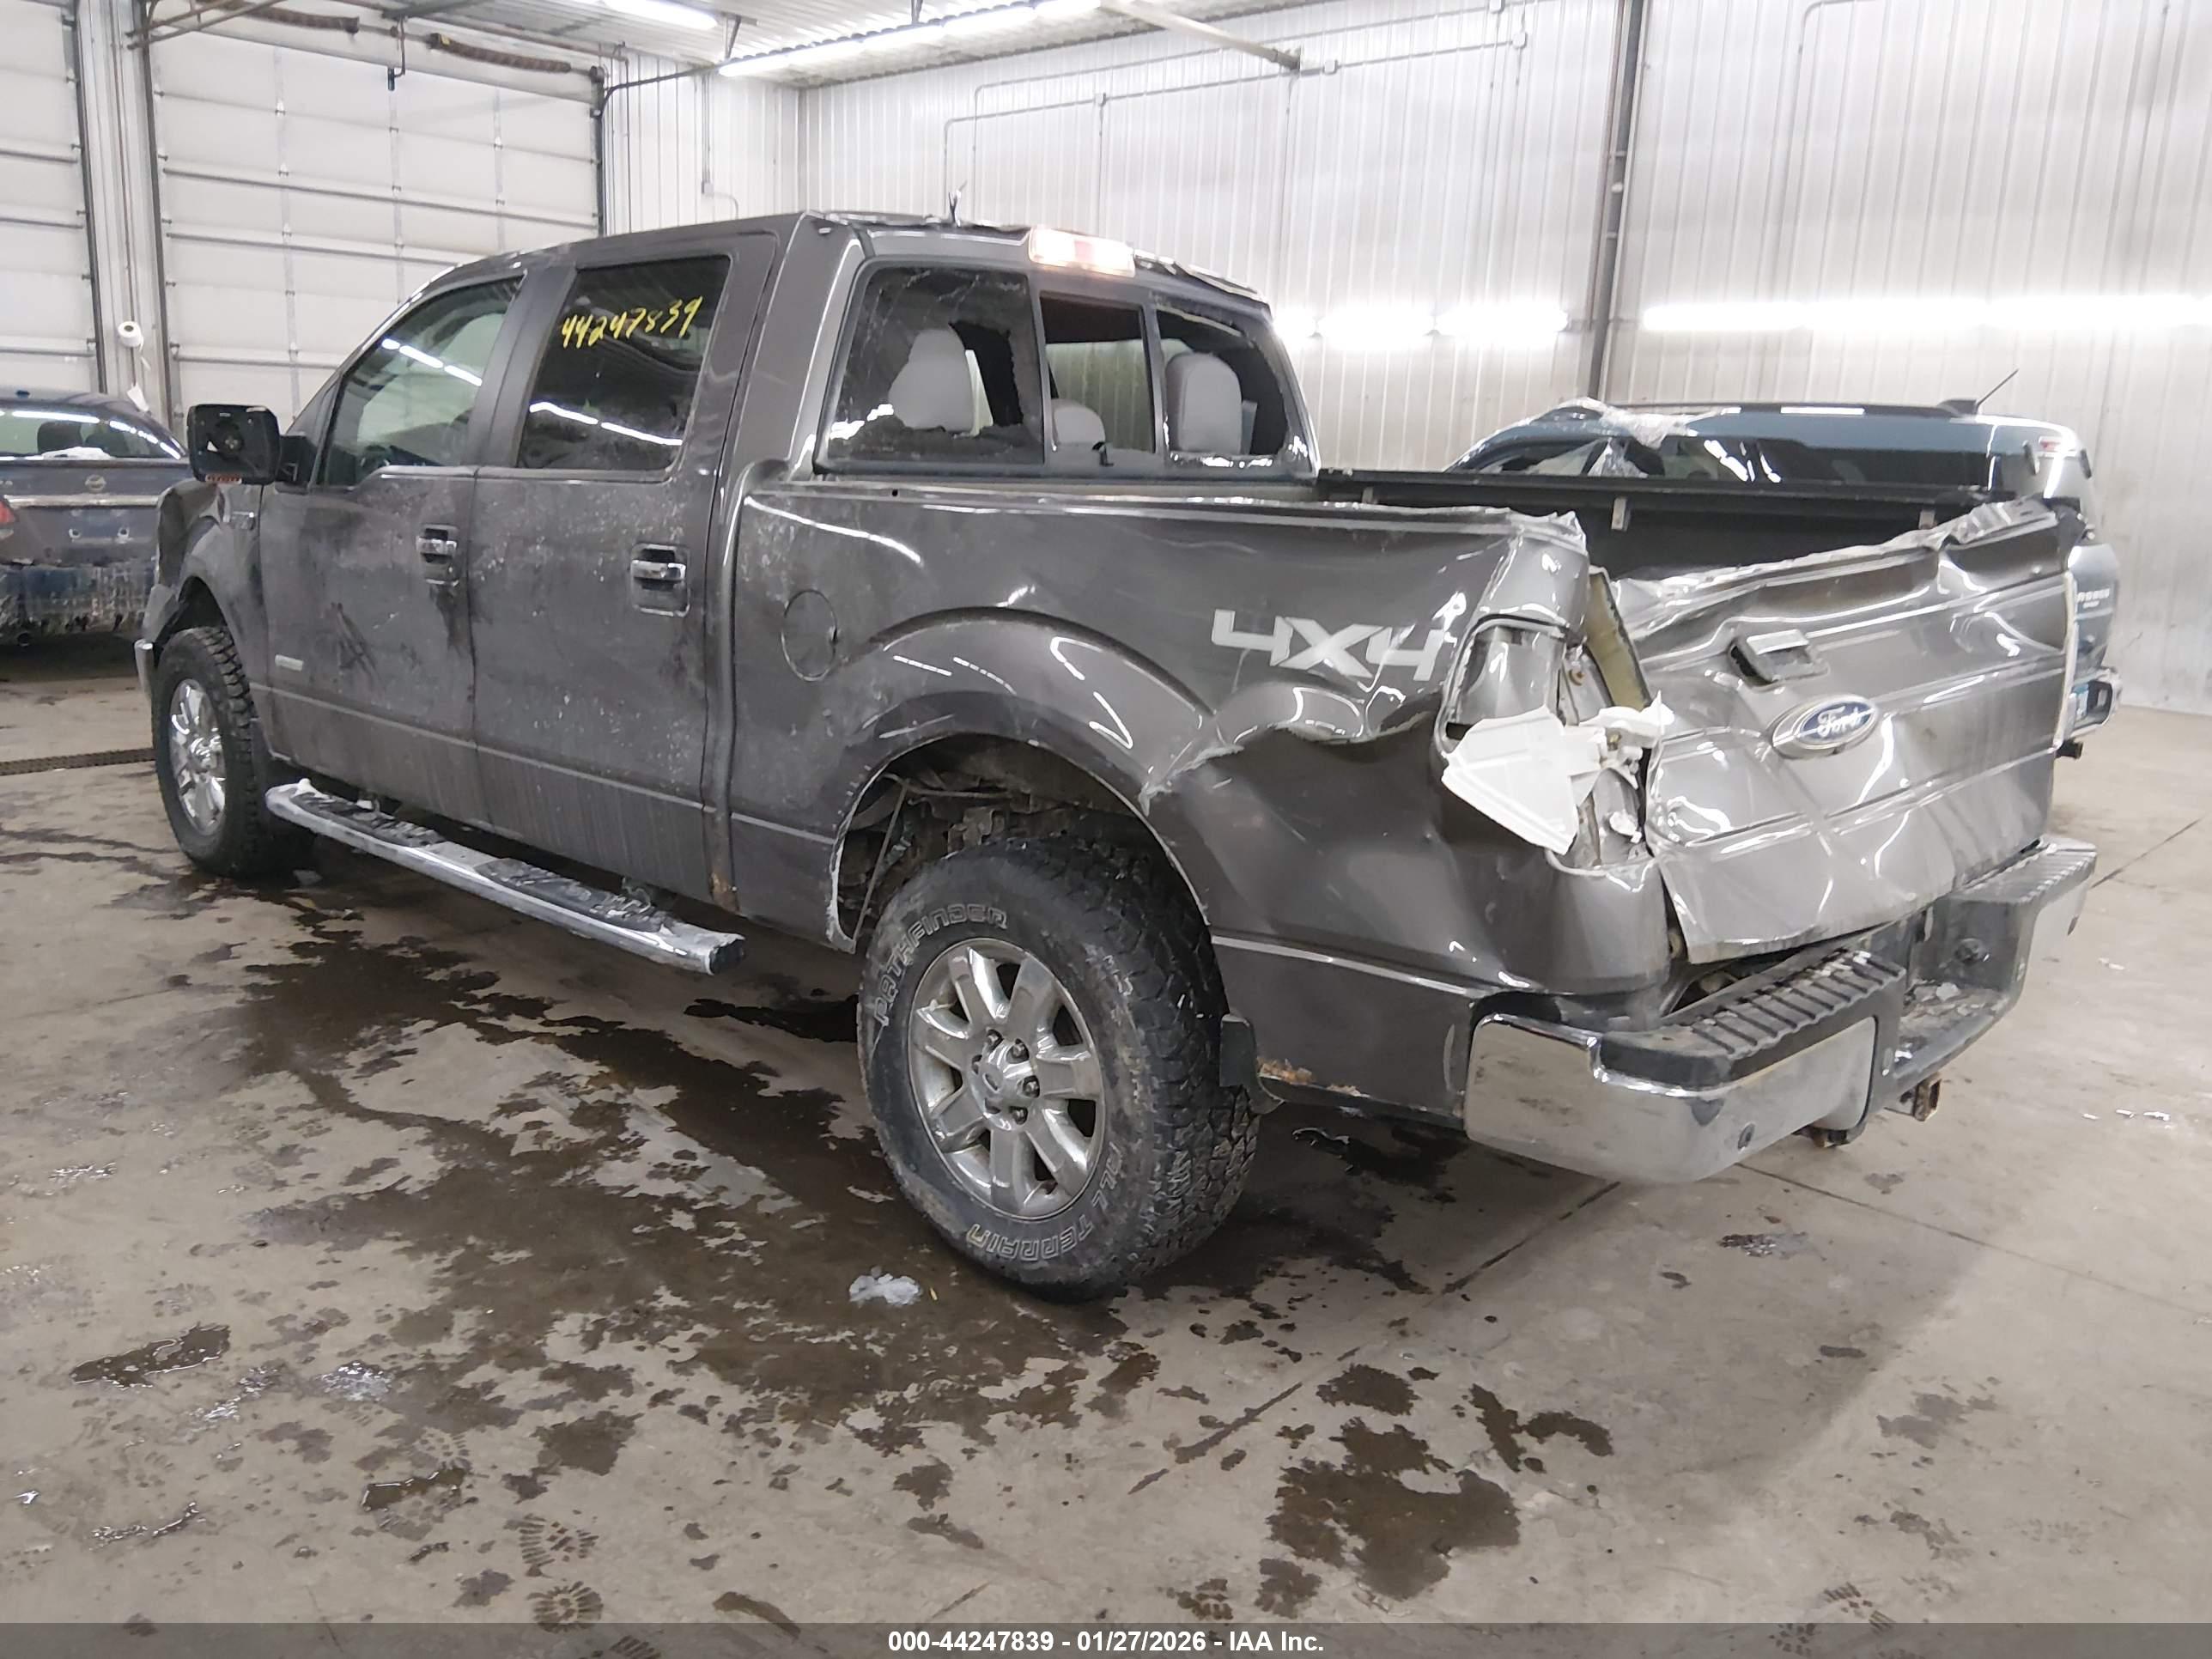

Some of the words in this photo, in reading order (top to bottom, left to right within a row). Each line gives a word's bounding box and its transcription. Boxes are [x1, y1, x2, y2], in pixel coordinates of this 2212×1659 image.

[562, 295, 702, 349] 44247839
[1808, 704, 1869, 738] Ford
[873, 903, 1009, 1026] PATHFINDER
[966, 1214, 1095, 1261] TERRAIN
